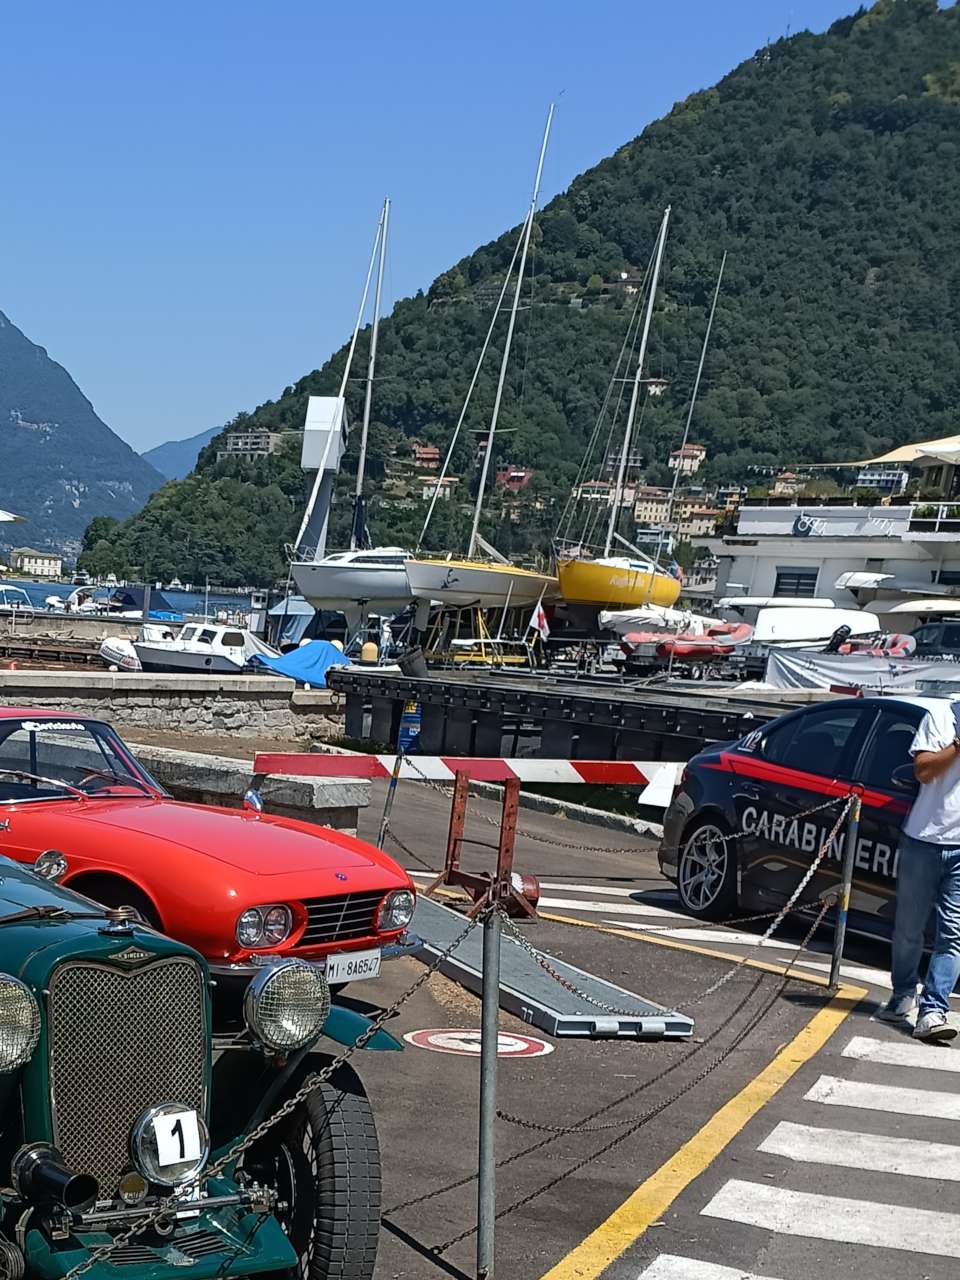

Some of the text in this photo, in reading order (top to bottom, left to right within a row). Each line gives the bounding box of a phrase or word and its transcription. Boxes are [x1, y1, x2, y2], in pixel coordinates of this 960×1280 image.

[742, 730, 762, 749] 112
[742, 806, 900, 879] CARABINERI
[171, 1119, 185, 1159] 1
